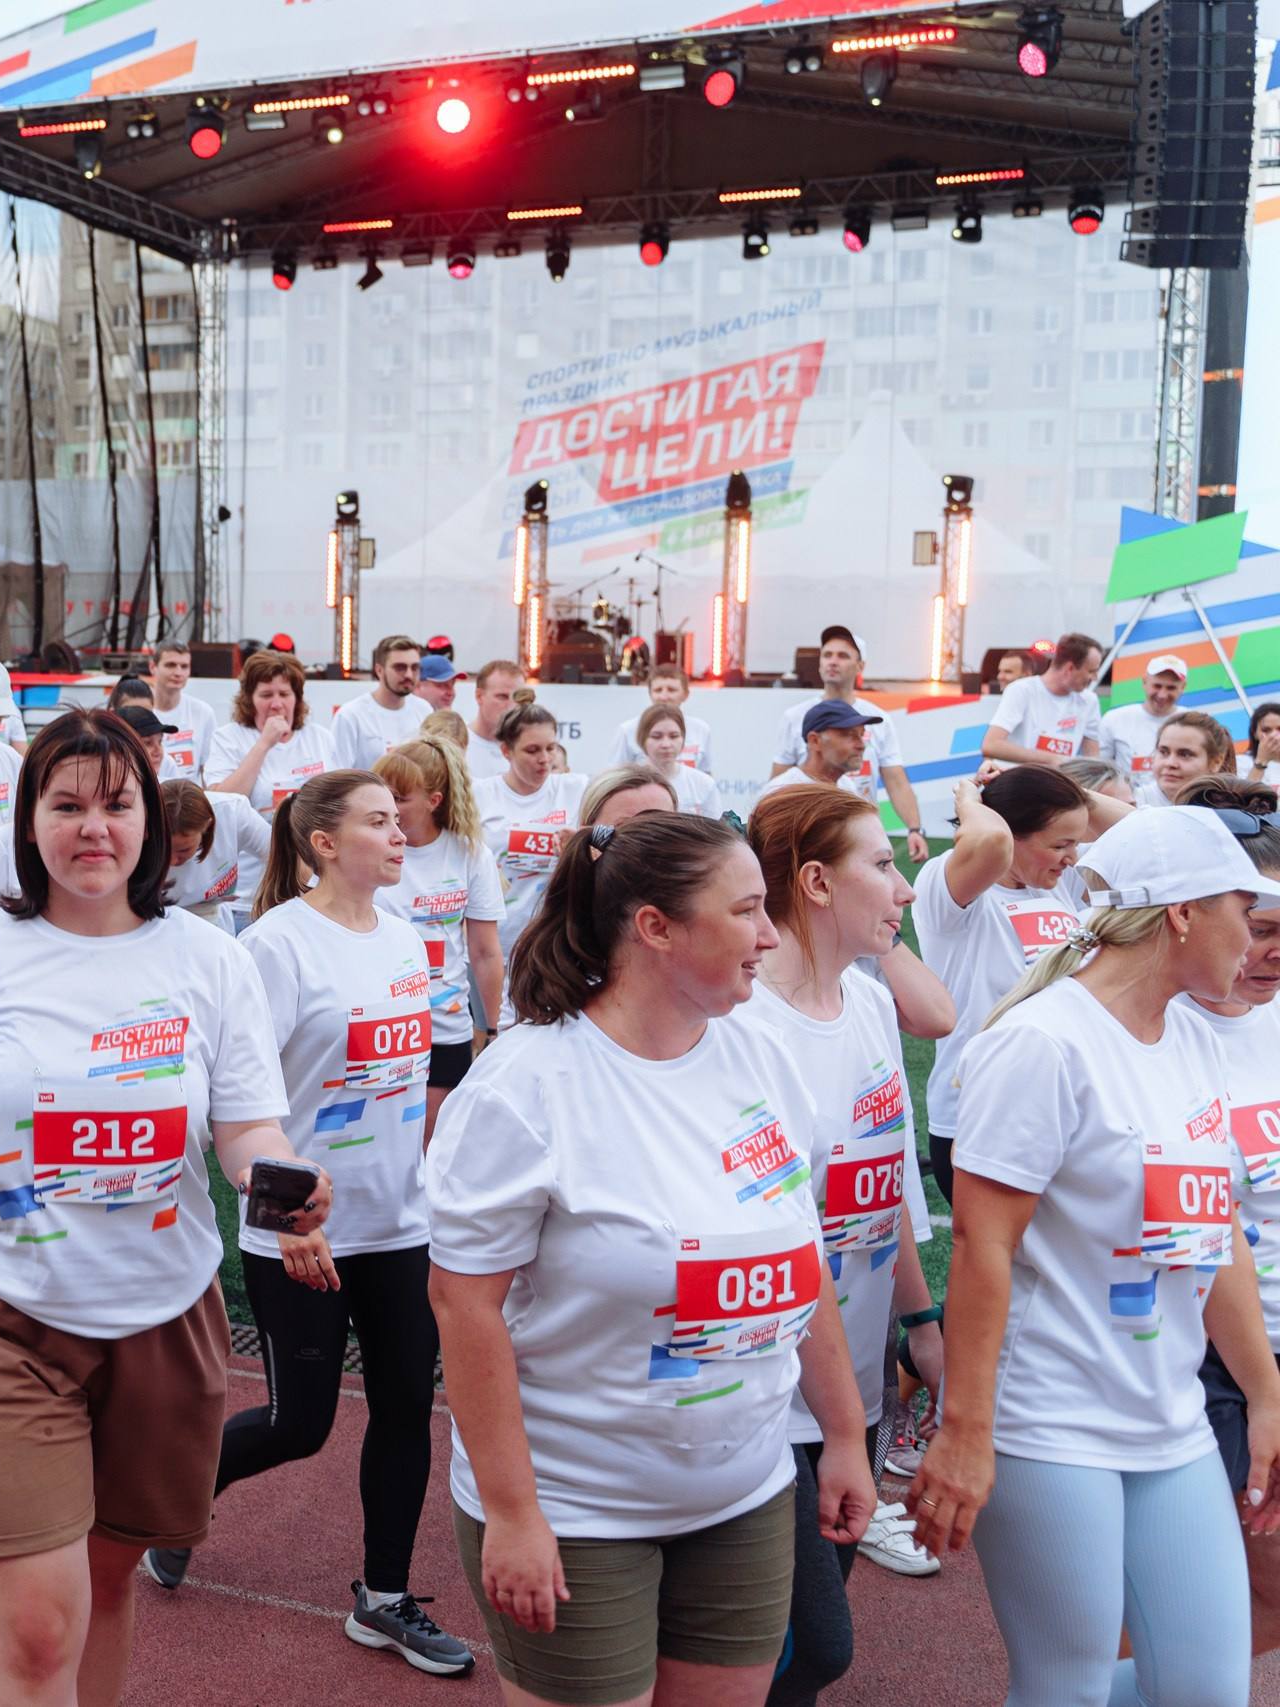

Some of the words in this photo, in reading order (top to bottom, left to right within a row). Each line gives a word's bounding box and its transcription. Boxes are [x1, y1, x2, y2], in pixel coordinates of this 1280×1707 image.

[521, 353, 803, 471] ДОСТИГАЯ
[609, 404, 789, 491] ЦЕЛИ!
[557, 722, 581, 740] ТБ
[524, 834, 556, 854] 43
[97, 1020, 184, 1050] ДОСТИГАЯ
[124, 1035, 181, 1063] ЦЕЛИ!
[373, 1019, 423, 1055] 072
[72, 1117, 156, 1158] 212
[728, 1123, 784, 1169] ДОСТИГА
[750, 1141, 791, 1176] ЦЕЛИ
[854, 1159, 904, 1206] 078
[1178, 1173, 1231, 1217] 075
[717, 1260, 796, 1311] 081
